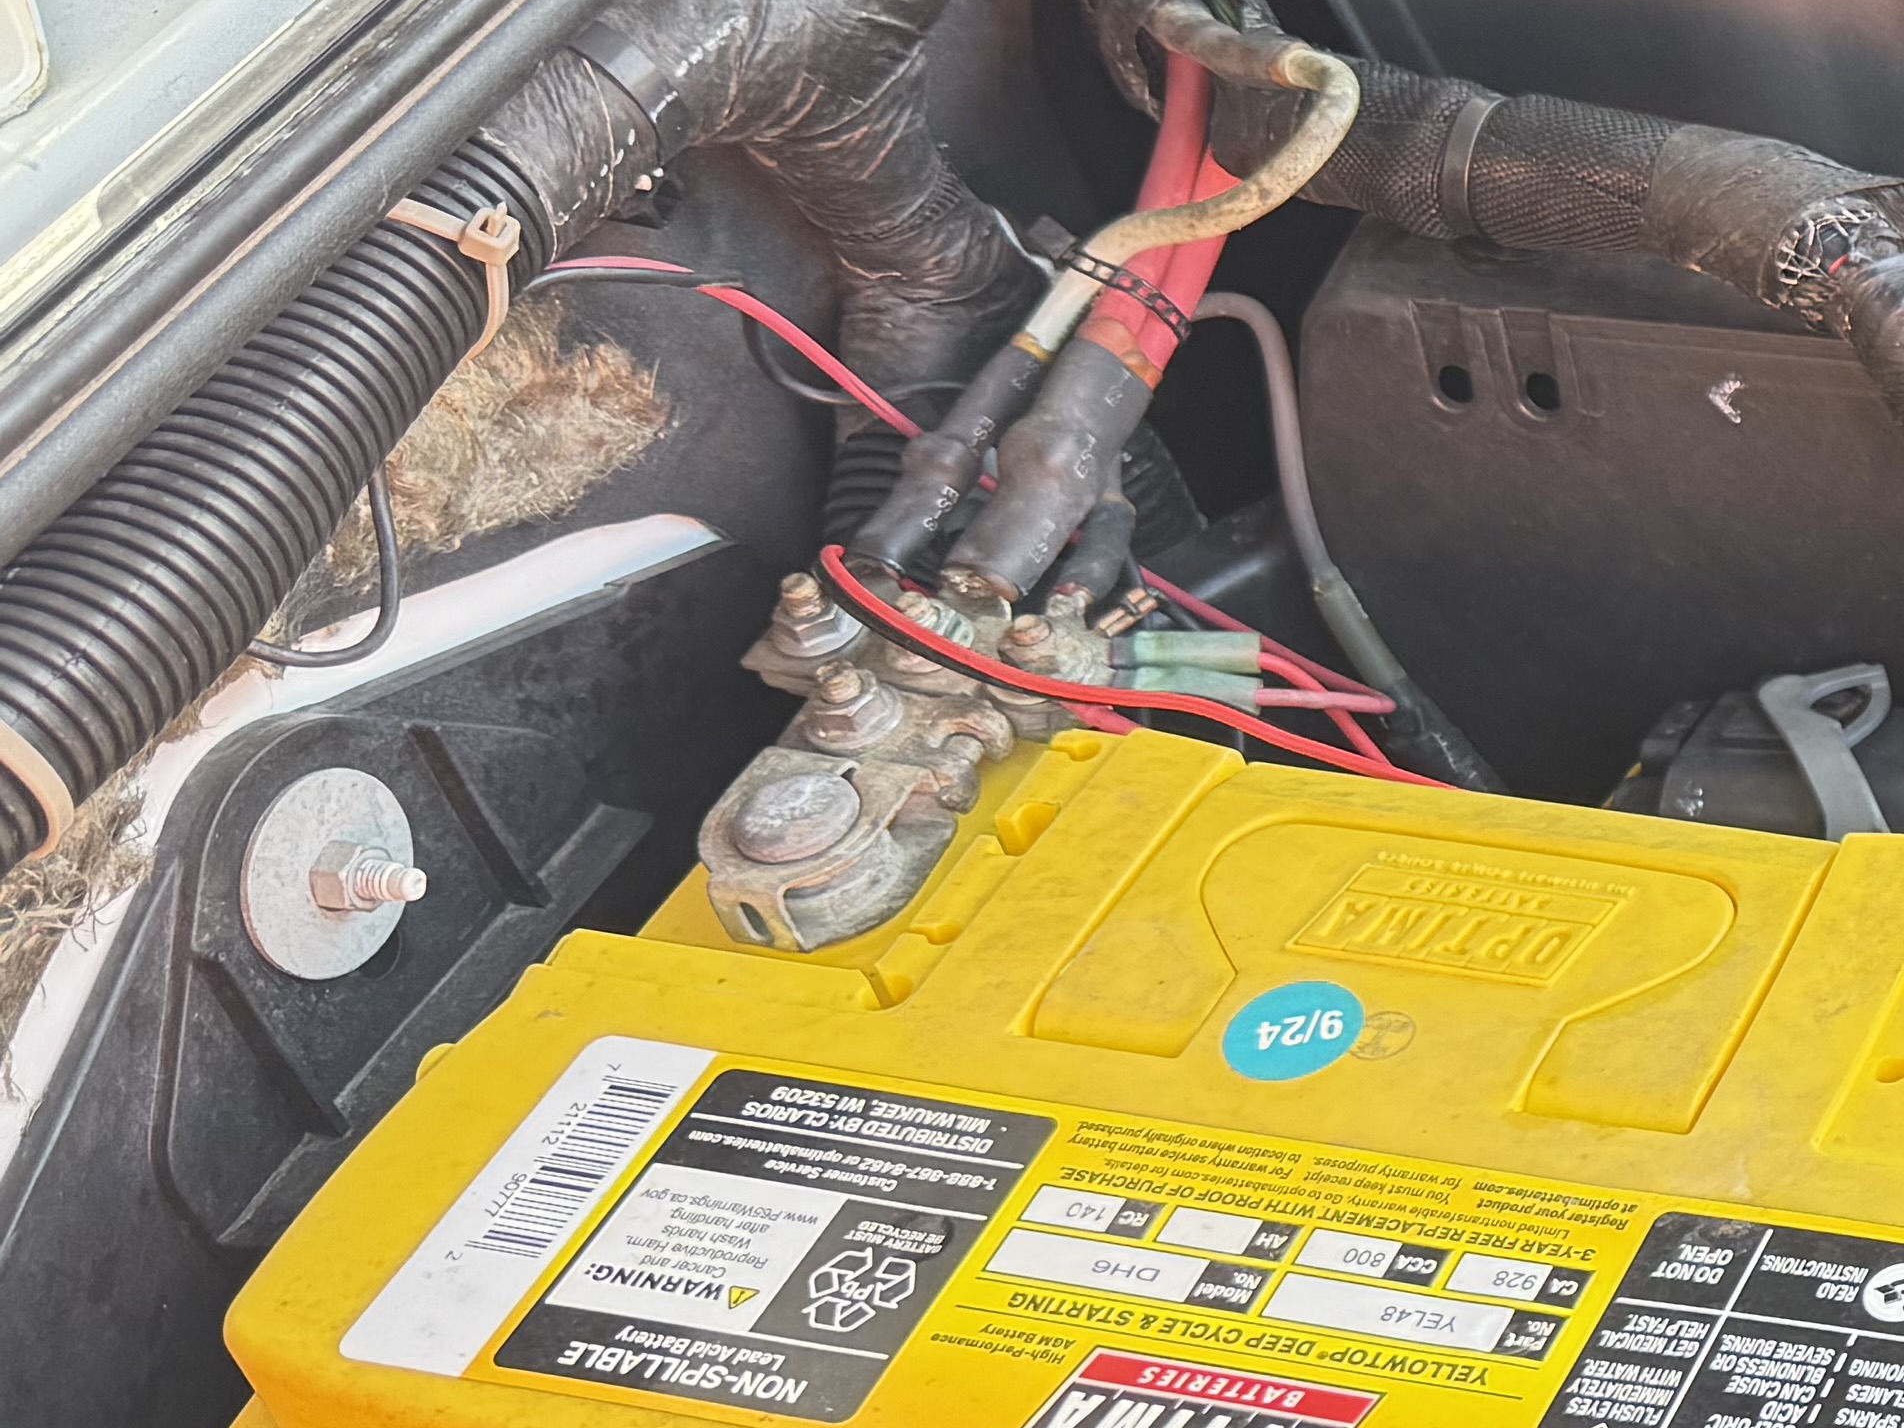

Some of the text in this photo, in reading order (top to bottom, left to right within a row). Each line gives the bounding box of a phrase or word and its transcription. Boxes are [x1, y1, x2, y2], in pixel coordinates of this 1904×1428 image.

[920, 484, 960, 533] ES-3
[1309, 897, 1581, 968] OPTIMA
[1253, 1004, 1347, 1052] 9/24
[769, 1085, 990, 1133] MILWAUKEE, WI 53209
[741, 1100, 993, 1154] DISTRIBUTED BY: CLARIOS
[1075, 1120, 1302, 1164] to location where originally purchased.
[443, 1062, 622, 1261] 7 21112 90777 2
[1066, 1132, 1294, 1180] For warranty service return battery
[763, 1158, 898, 1192] Customer Service
[1302, 1169, 1451, 1206] You must keep receipt
[1312, 1156, 1463, 1191] for warranty purposes.
[639, 1187, 818, 1224] www.P65Warnings.ca.gov
[1103, 1157, 1570, 1240] Limited nontransferable warranty. Go to optimabatteries.com for details.
[1472, 1181, 1639, 1214] at optimabatteries.com
[669, 1206, 771, 1234] after handling.
[1059, 1166, 1596, 1262] 3-YEAR FREE REPLACEMENT WITH PROOF OF PURCHASE.
[1064, 1201, 1149, 1227] RC 140
[1475, 1197, 1629, 1231] Register your product
[625, 1234, 769, 1269] Reproductive Harm.
[660, 1223, 751, 1249] Wash hands
[842, 1229, 886, 1245] MUST
[1253, 1231, 1288, 1249] AH
[637, 1253, 727, 1279] Cancer and
[1341, 1247, 1437, 1274] CCA 800
[1678, 1243, 1733, 1266] OPEN.
[1752, 1254, 1868, 1283] INSTRUCTIONS.
[584, 1263, 723, 1300] WARNING:
[1090, 1258, 1253, 1304] Model DH6
[1232, 1271, 1262, 1290] No.
[1491, 1269, 1579, 1296] CA 928
[1650, 1260, 1724, 1284] DO NOT
[839, 1277, 879, 1300] Pb
[1815, 1281, 1859, 1303] READ
[1007, 1291, 1134, 1326] STARTING
[1138, 1312, 1159, 1330] &
[978, 1322, 1077, 1350] AGM Battery
[1157, 1316, 1243, 1344] CYCLE
[1379, 1305, 1547, 1351] Part YEL48
[1526, 1319, 1556, 1337] No.
[1622, 1313, 1710, 1339] HELP FAST.
[614, 1324, 785, 1371] Lead Acid Battery
[930, 1332, 1065, 1364] High-Performance
[1243, 1332, 1317, 1357] DEEP
[1598, 1328, 1700, 1358] GET MEDICAL
[1719, 1333, 1835, 1366] SEVERE BURNS.
[558, 1341, 806, 1402] NON-SPILLABLE
[1581, 1358, 1683, 1387] WITH WATER.
[1708, 1352, 1826, 1384] BLINDNESS OR
[1137, 1366, 1304, 1407] BATTERIES
[1566, 1377, 1674, 1406] IMMEDIATELY
[1724, 1374, 1816, 1403] CAN CAUSE
[1564, 1396, 1664, 1426] FLUSH EYES
[1758, 1400, 1807, 1424] ACID
